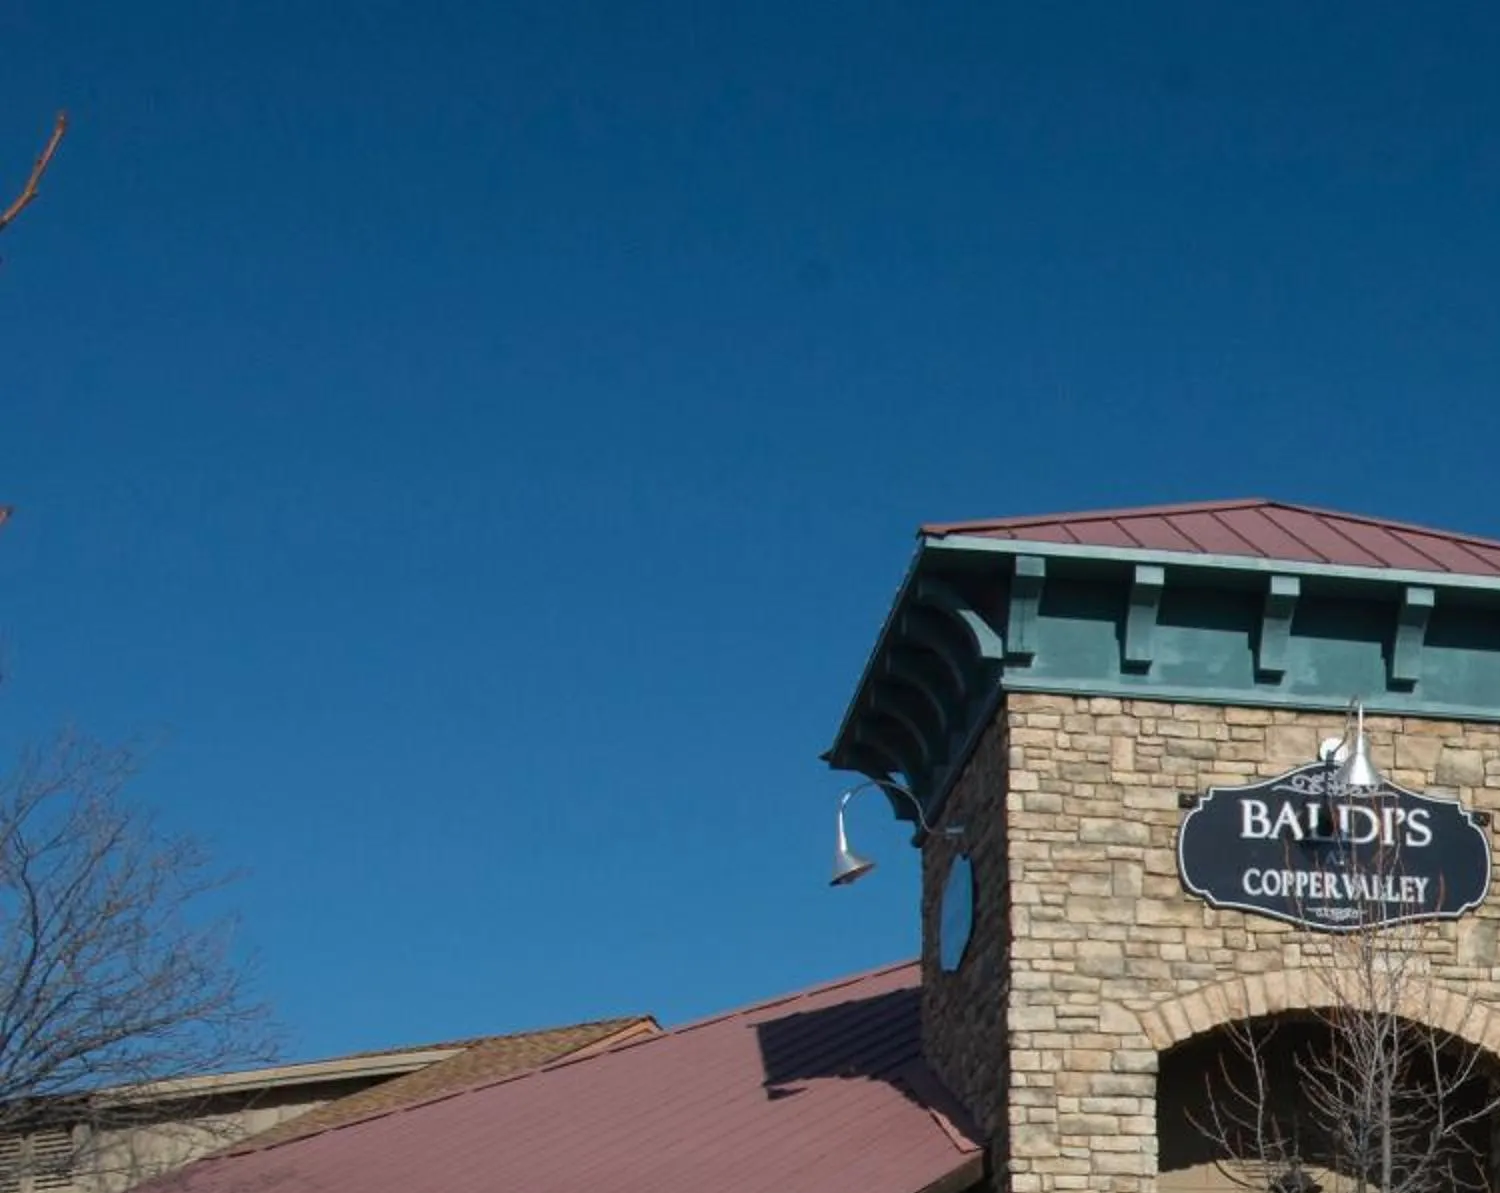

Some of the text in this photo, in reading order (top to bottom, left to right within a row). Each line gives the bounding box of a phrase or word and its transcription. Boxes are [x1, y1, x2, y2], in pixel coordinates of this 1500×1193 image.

[1239, 799, 1433, 848] BALDI'S
[1242, 867, 1430, 903] COPPER VALLEY
